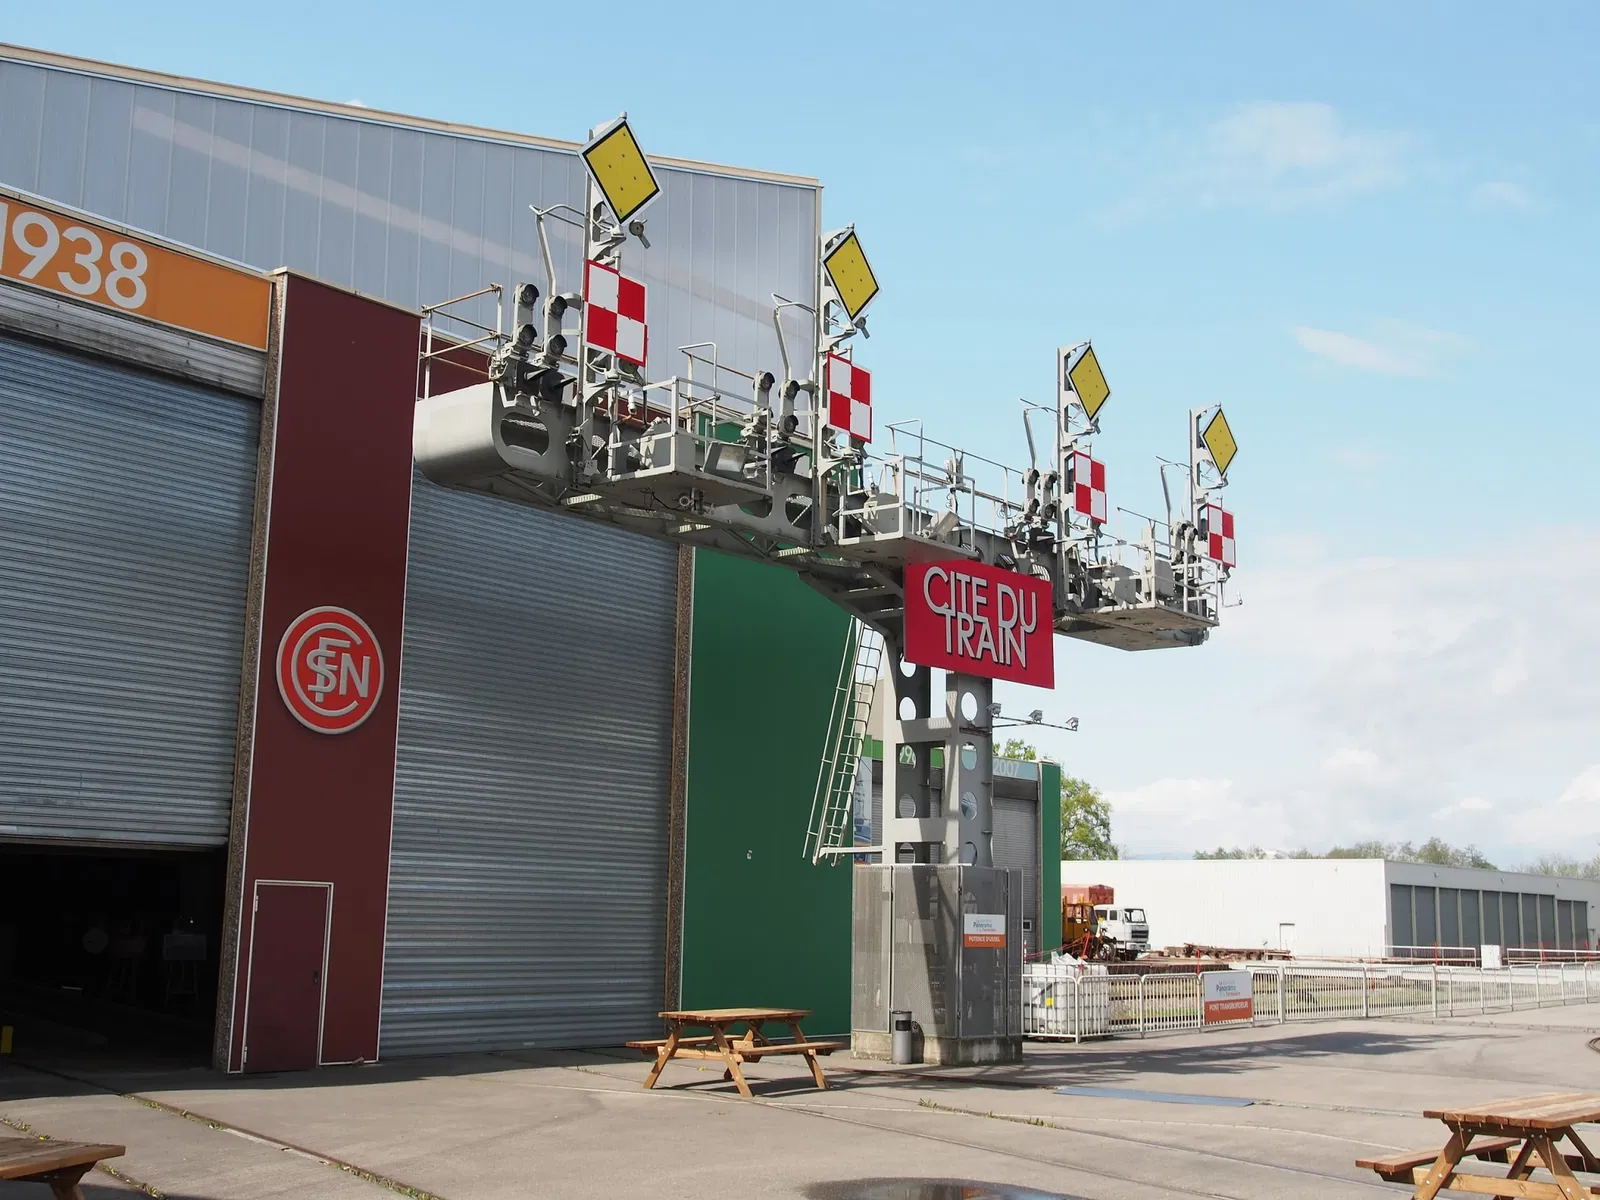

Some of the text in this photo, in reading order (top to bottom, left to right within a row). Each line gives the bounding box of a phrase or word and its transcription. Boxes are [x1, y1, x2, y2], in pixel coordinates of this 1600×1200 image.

[923, 566, 1037, 634] CITE DU
[939, 609, 1027, 668] TRAIN
